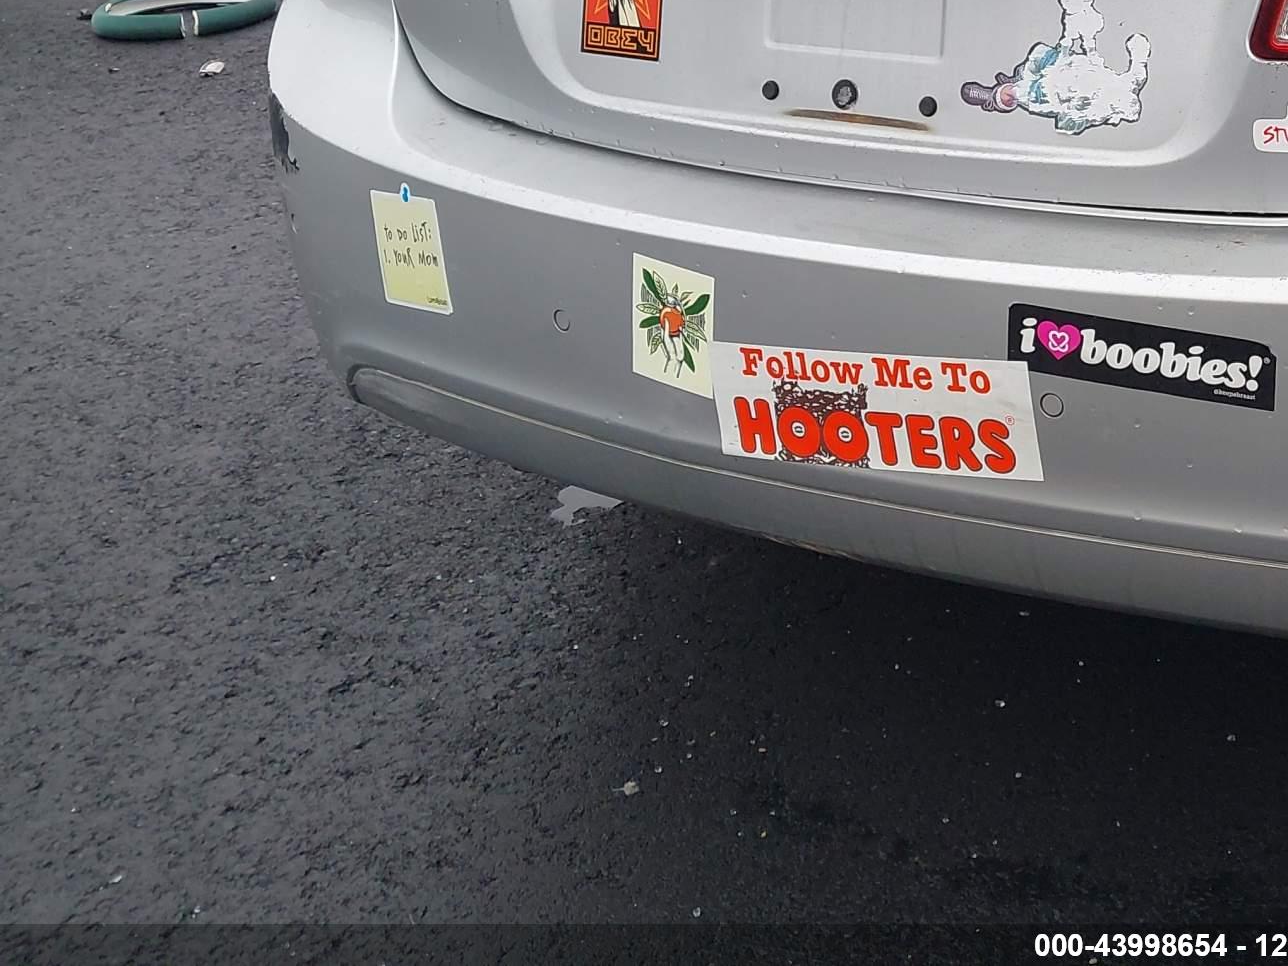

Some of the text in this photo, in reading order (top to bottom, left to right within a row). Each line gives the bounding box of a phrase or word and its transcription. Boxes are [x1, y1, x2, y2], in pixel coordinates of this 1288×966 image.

[588, 24, 654, 52] OBEY
[739, 347, 992, 394] Follow Me To
[1020, 317, 1263, 392] i boobies!
[733, 396, 1017, 474] HOOTERS
